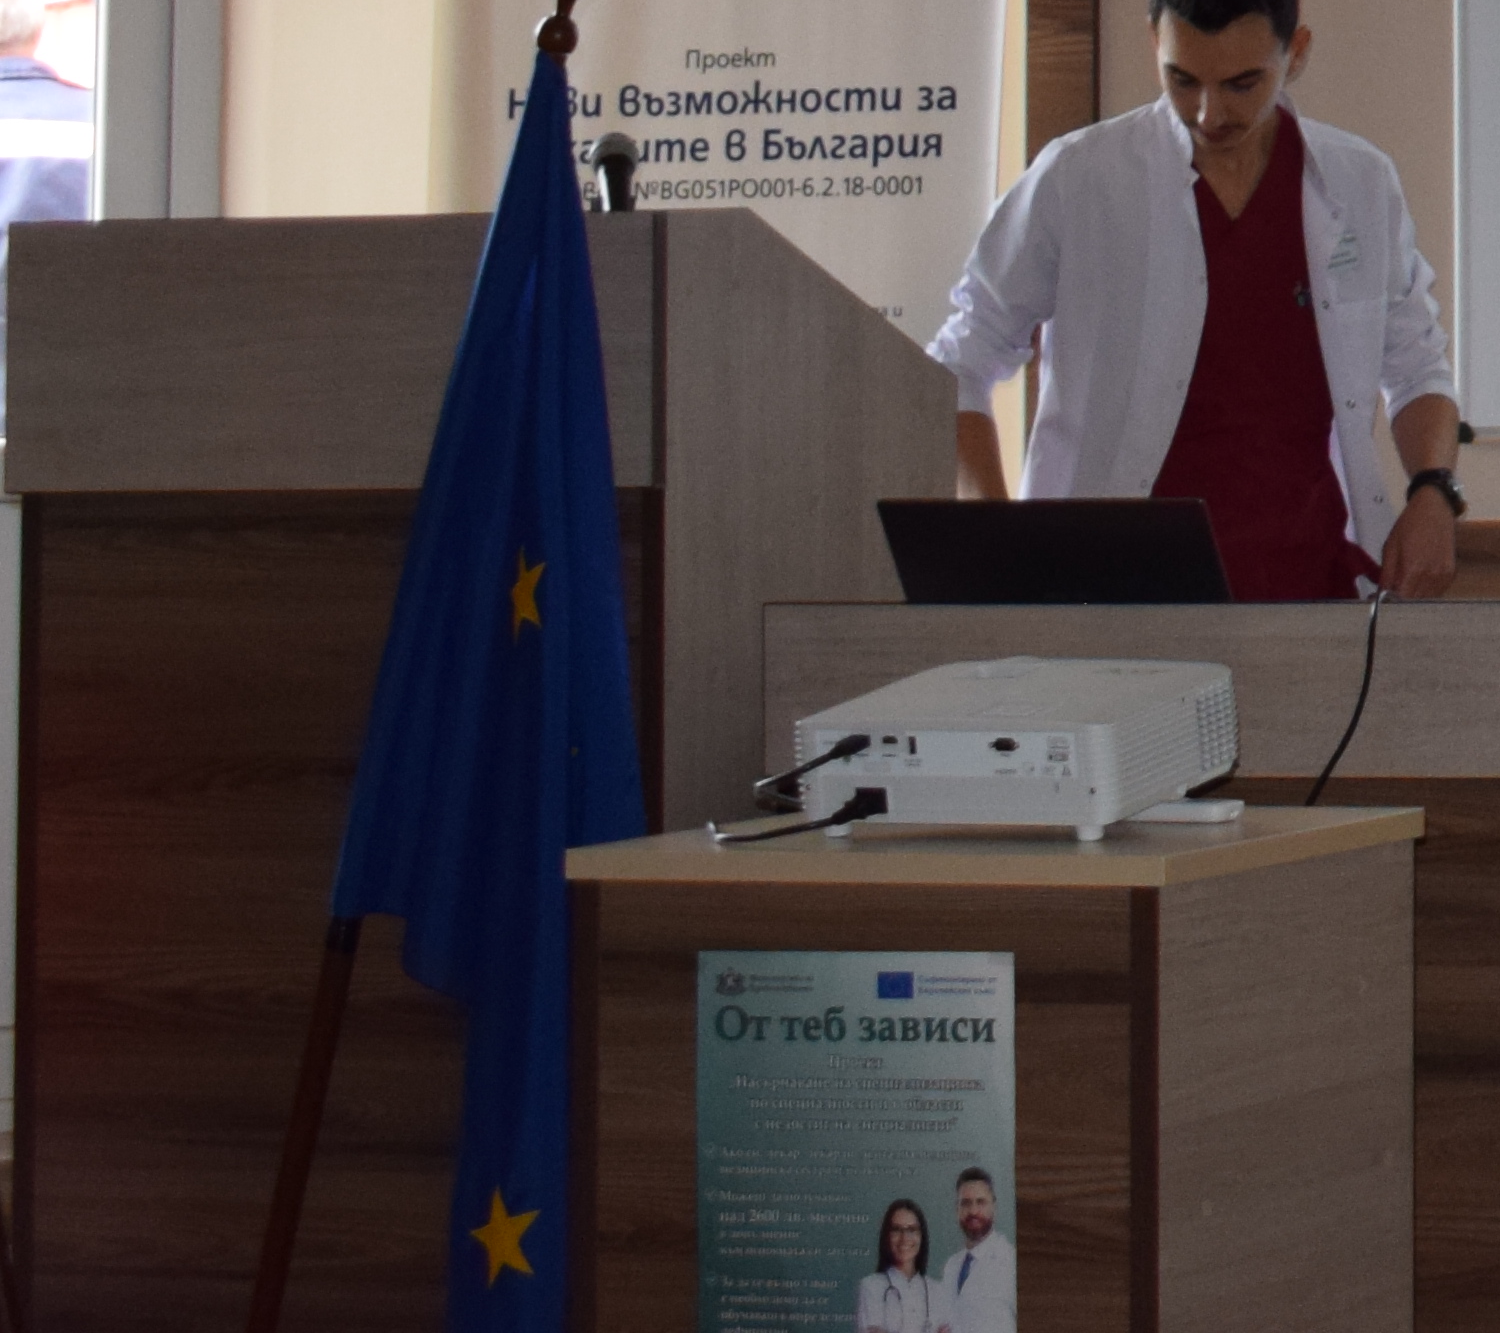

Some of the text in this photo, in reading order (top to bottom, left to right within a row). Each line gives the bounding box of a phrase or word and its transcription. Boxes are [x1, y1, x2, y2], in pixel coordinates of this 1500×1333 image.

[685, 49, 777, 72] Проект
[508, 82, 957, 119] Нви възможности за
[725, 130, 747, 161] в
[762, 130, 943, 169] България
[715, 1005, 996, 1043] От теб зависи
